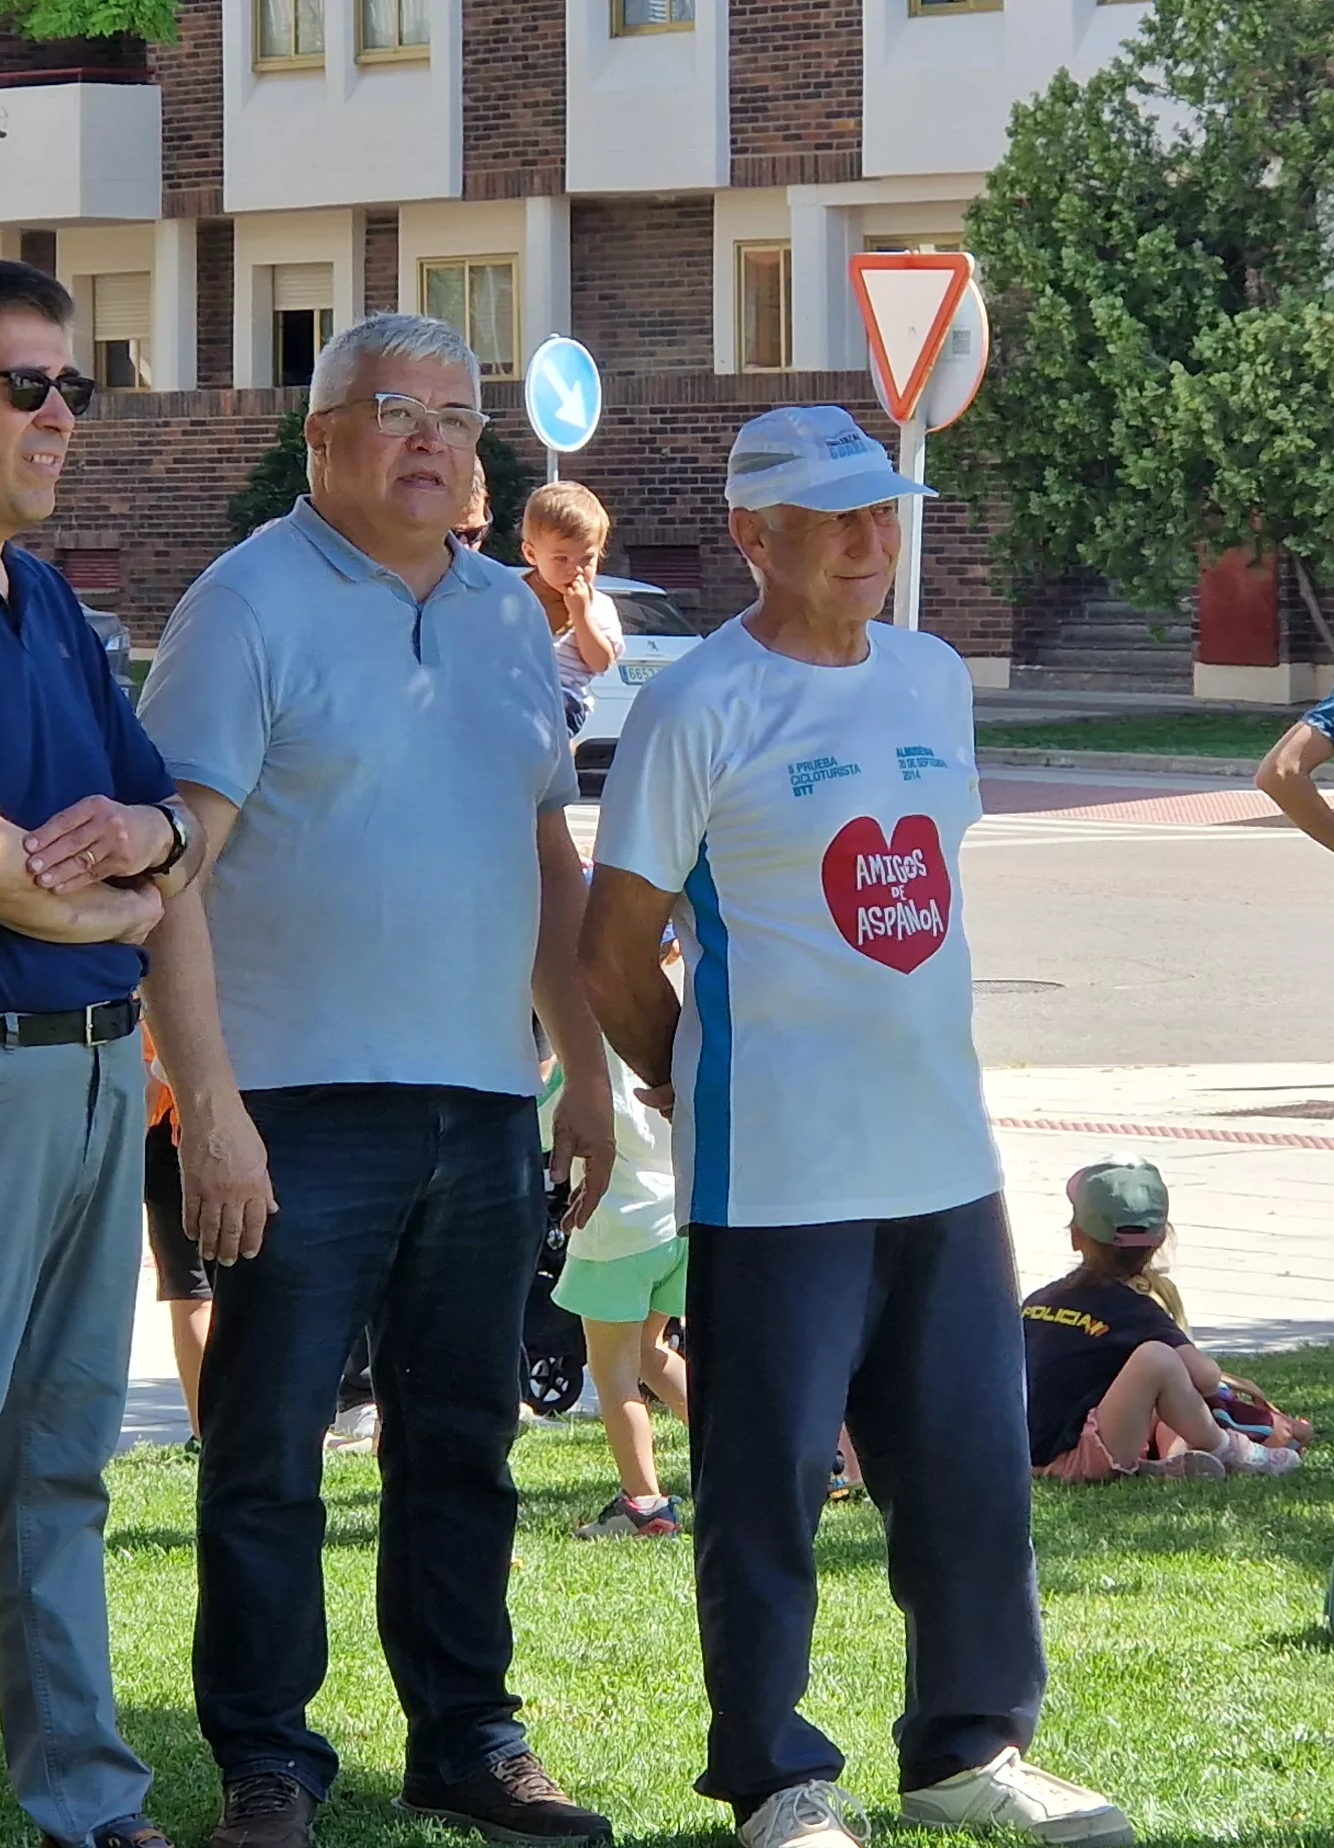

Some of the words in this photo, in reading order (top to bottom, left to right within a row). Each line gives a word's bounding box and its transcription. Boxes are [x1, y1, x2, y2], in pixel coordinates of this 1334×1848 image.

[790, 763, 862, 786] CICLOTURISTA
[796, 756, 838, 773] PRUEBA
[902, 768, 921, 781] 2014
[792, 784, 814, 797] BTT
[856, 848, 928, 891] AMIGOS
[890, 885, 907, 901] DE
[857, 898, 944, 946] ASPANOA
[1021, 1305, 1092, 1333] POLICIA
